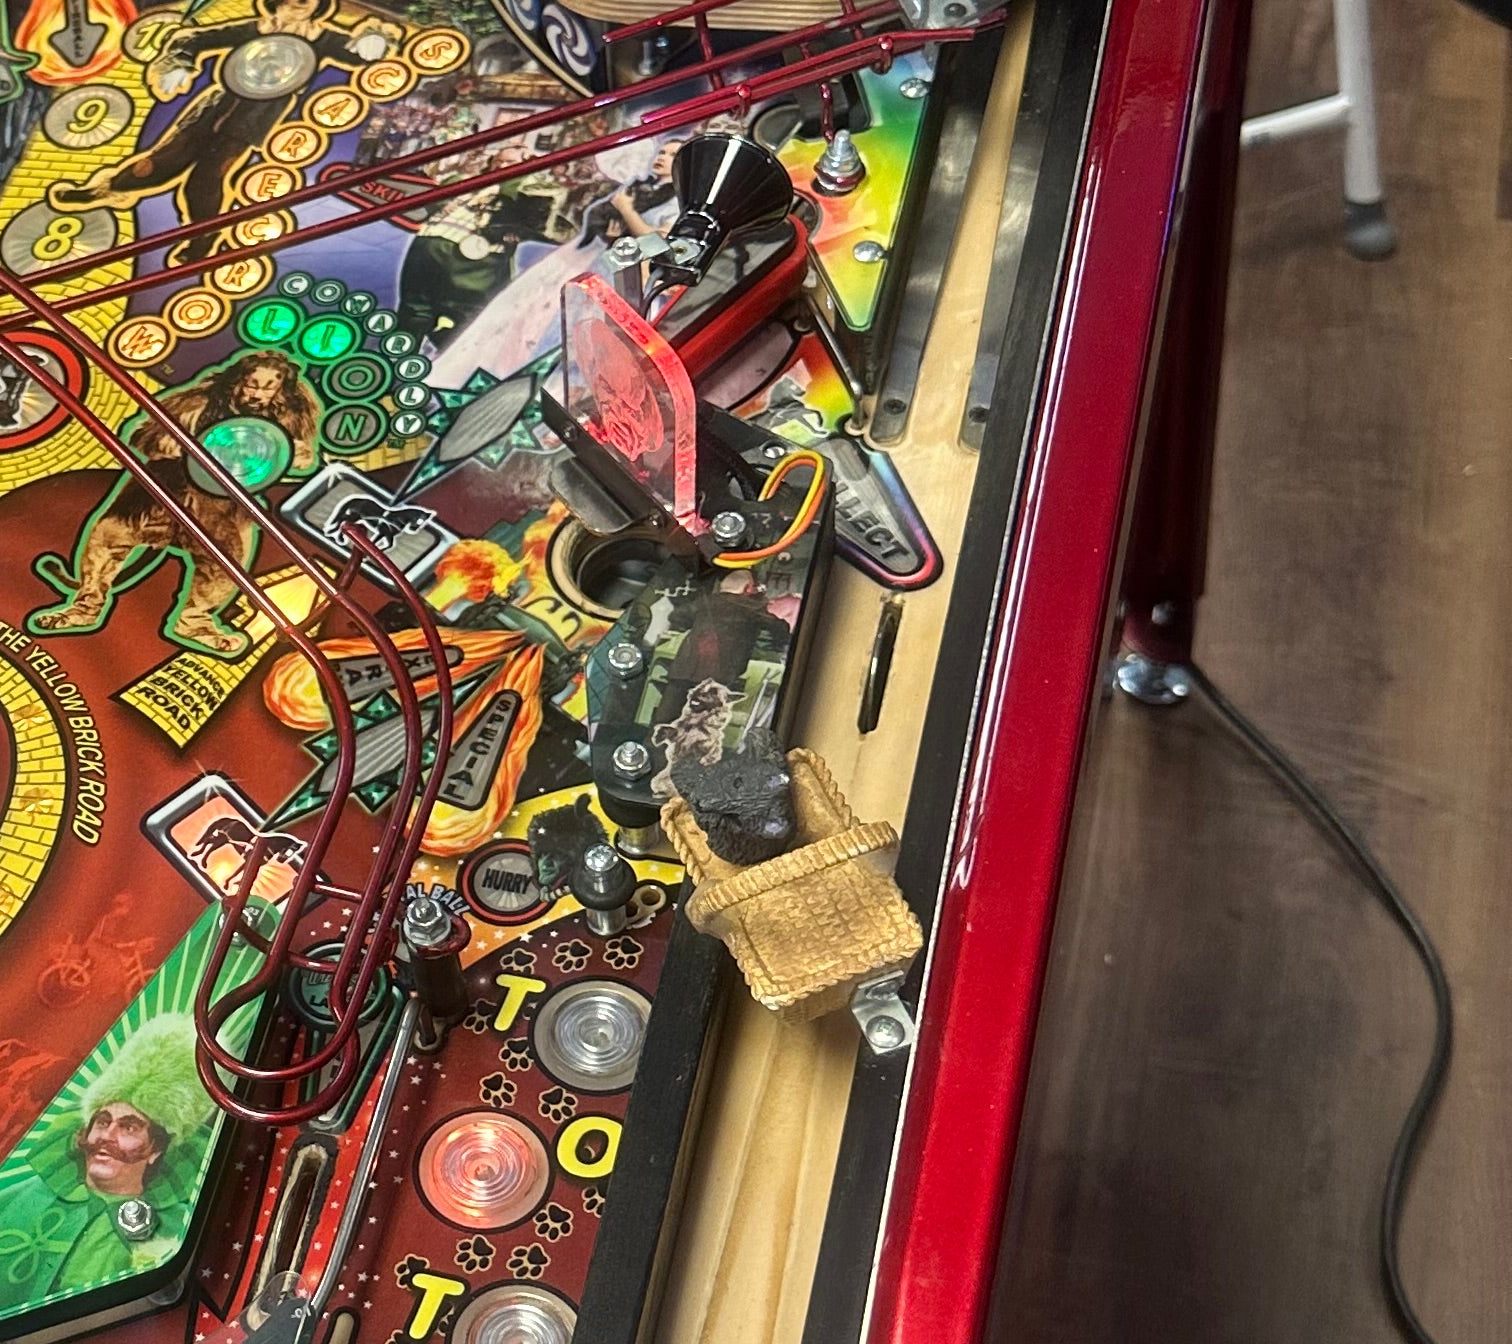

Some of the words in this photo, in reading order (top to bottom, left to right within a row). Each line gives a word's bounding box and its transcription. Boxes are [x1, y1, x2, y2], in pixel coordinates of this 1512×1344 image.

[66, 98, 108, 135] 9
[31, 215, 85, 262] 8
[836, 483, 910, 559] LLECT
[24, 645, 88, 712] YELLOW
[150, 674, 205, 721] BRICK
[161, 664, 220, 712] YELLOW
[174, 656, 227, 699] ADVANCE
[137, 685, 193, 731] ROAD
[68, 715, 106, 777] BRICK
[443, 699, 512, 801] SPECIAL
[72, 775, 106, 846] ROAD
[480, 867, 533, 896] HURRY
